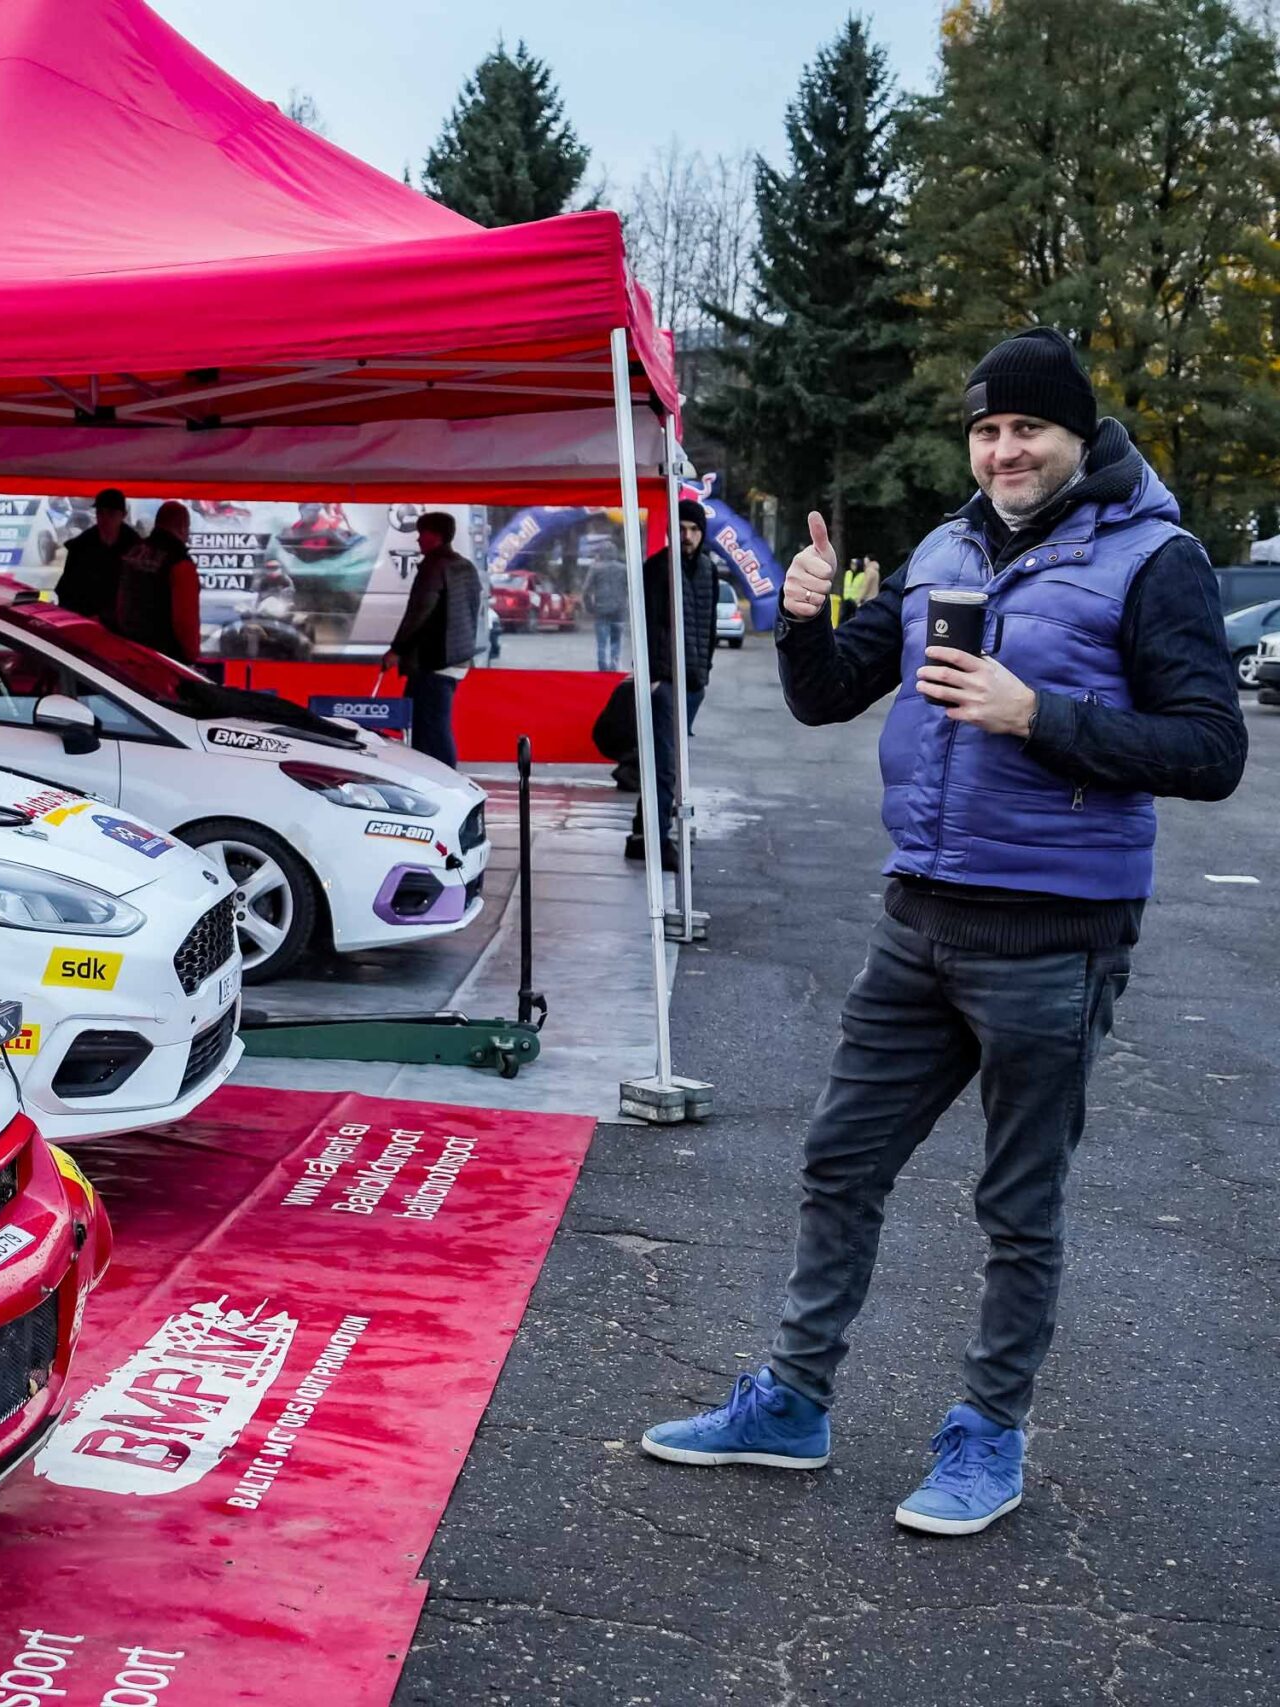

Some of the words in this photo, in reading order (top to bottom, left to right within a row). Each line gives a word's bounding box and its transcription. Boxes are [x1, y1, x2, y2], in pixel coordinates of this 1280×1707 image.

[242, 554, 255, 568] &
[333, 702, 390, 717] sparco
[368, 821, 433, 842] can-am
[61, 957, 107, 981] sdk
[227, 1457, 285, 1510] BALTIC
[318, 1315, 371, 1379] PROMOTION
